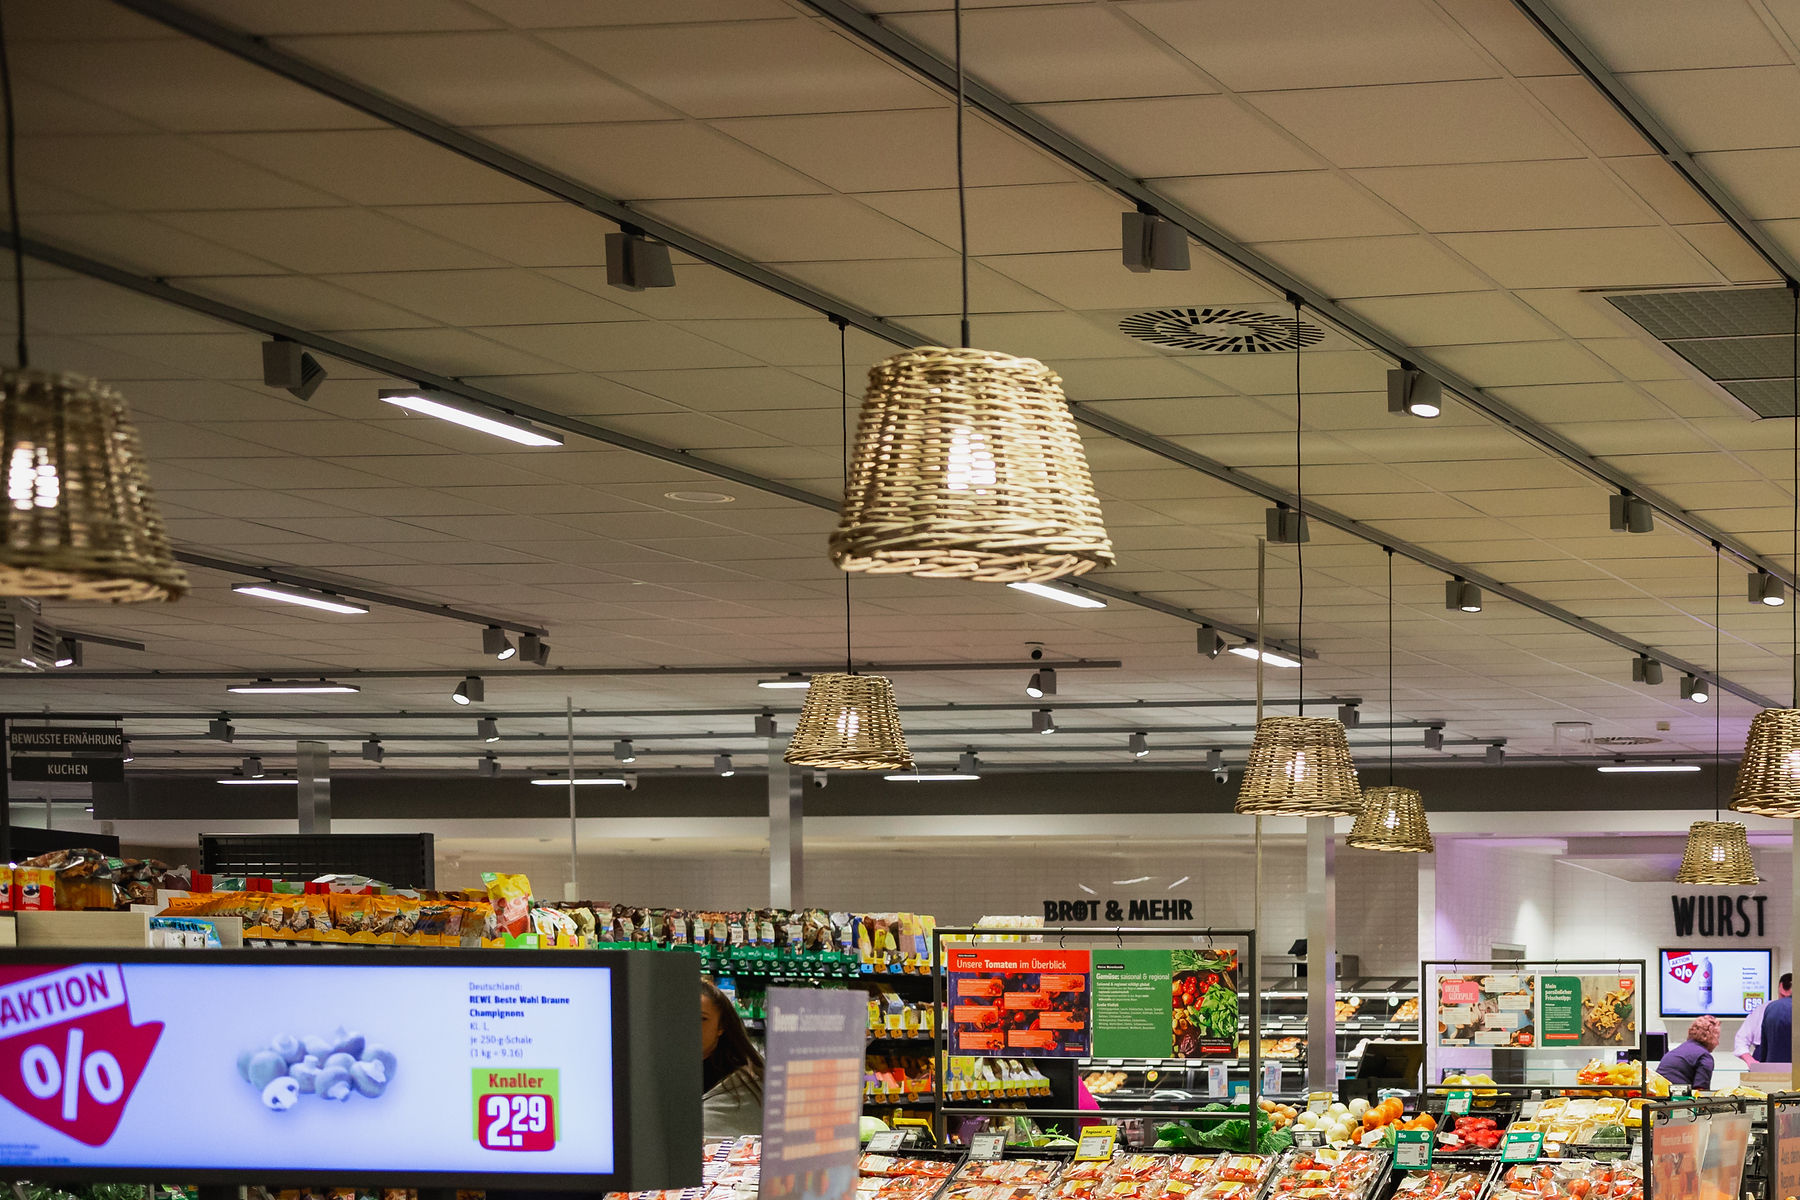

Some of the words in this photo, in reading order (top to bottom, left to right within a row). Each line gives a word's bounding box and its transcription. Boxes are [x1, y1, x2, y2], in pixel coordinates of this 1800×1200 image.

[11, 733, 60, 744] BEWUSSTE
[63, 732, 122, 745] ERNÄHRUNG
[47, 764, 88, 775] KUCHEN
[1043, 900, 1100, 921] BROT
[1105, 900, 1123, 921] &
[1128, 900, 1193, 921] MEHR
[1671, 895, 1767, 937] WURST
[957, 960, 982, 969] Unsere
[985, 960, 1018, 969] Tomaten
[1020, 960, 1030, 969] im
[1032, 958, 1067, 970] Überblick
[0, 969, 109, 1027] AKTION
[469, 1009, 525, 1019] Champignons
[20, 1028, 124, 1121] %
[489, 1073, 544, 1088] Knaller
[487, 1095, 546, 1146] 2.29
